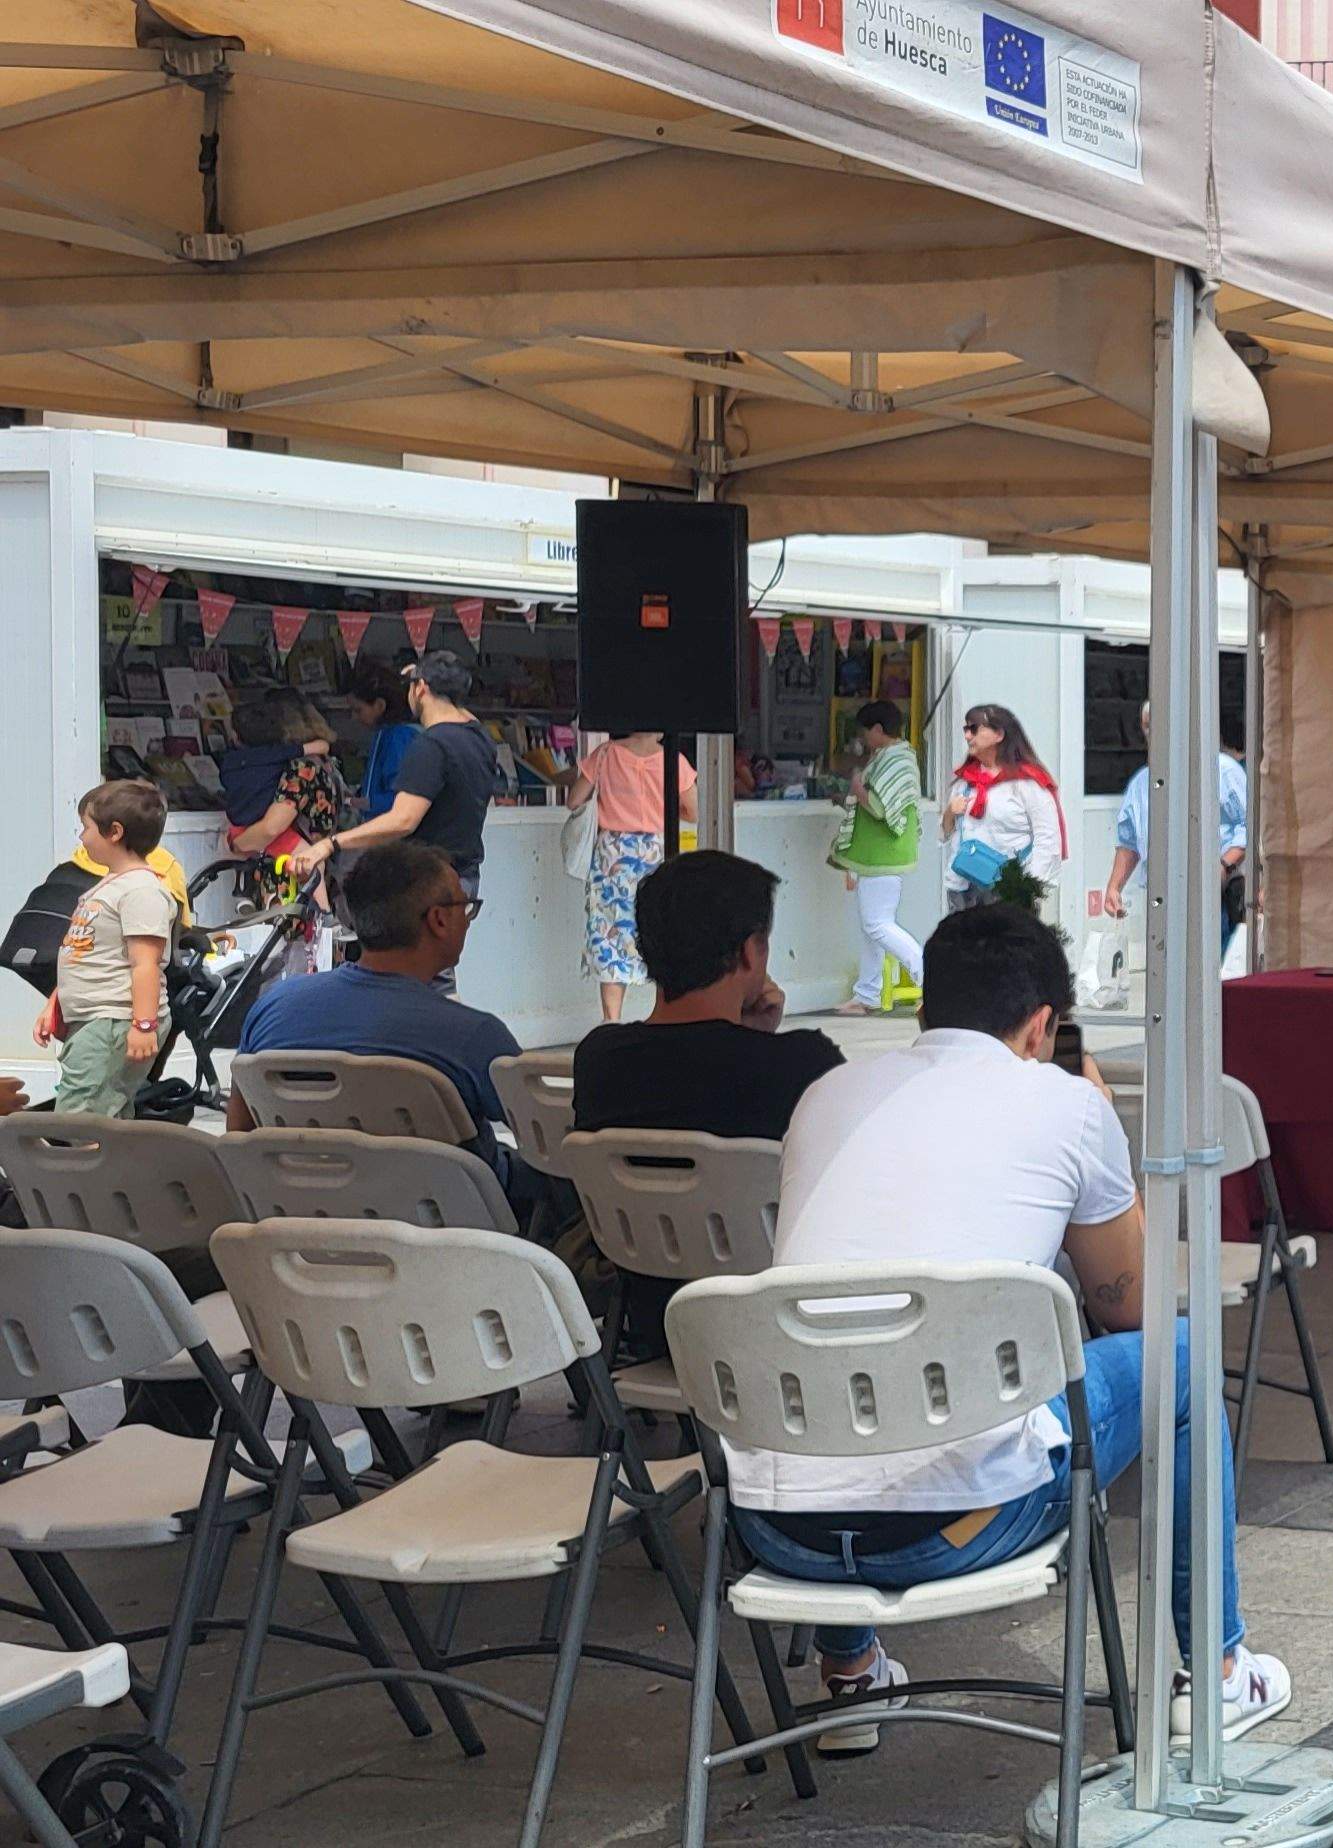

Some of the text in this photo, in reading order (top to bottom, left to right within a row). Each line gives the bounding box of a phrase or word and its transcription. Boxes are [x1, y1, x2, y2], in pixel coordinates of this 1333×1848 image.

[856, 21, 948, 77] de Huesca
[547, 539, 578, 562] Libre
[1249, 1669, 1267, 1703] N
